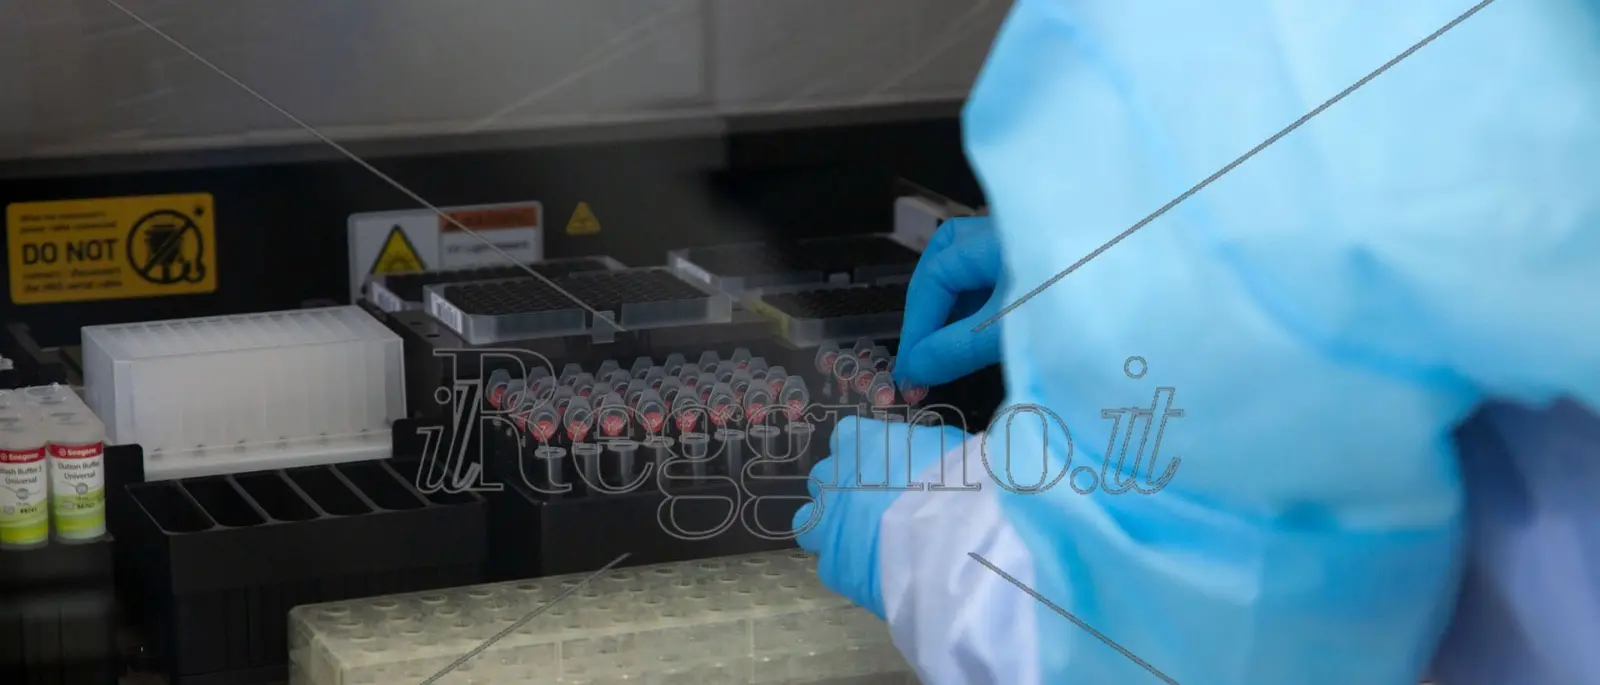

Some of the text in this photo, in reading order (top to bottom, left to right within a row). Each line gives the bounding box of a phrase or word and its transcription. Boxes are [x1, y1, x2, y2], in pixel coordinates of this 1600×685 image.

[22, 238, 119, 265] DO NOT
[5, 476, 38, 486] Universal
[63, 470, 96, 481] Universal
